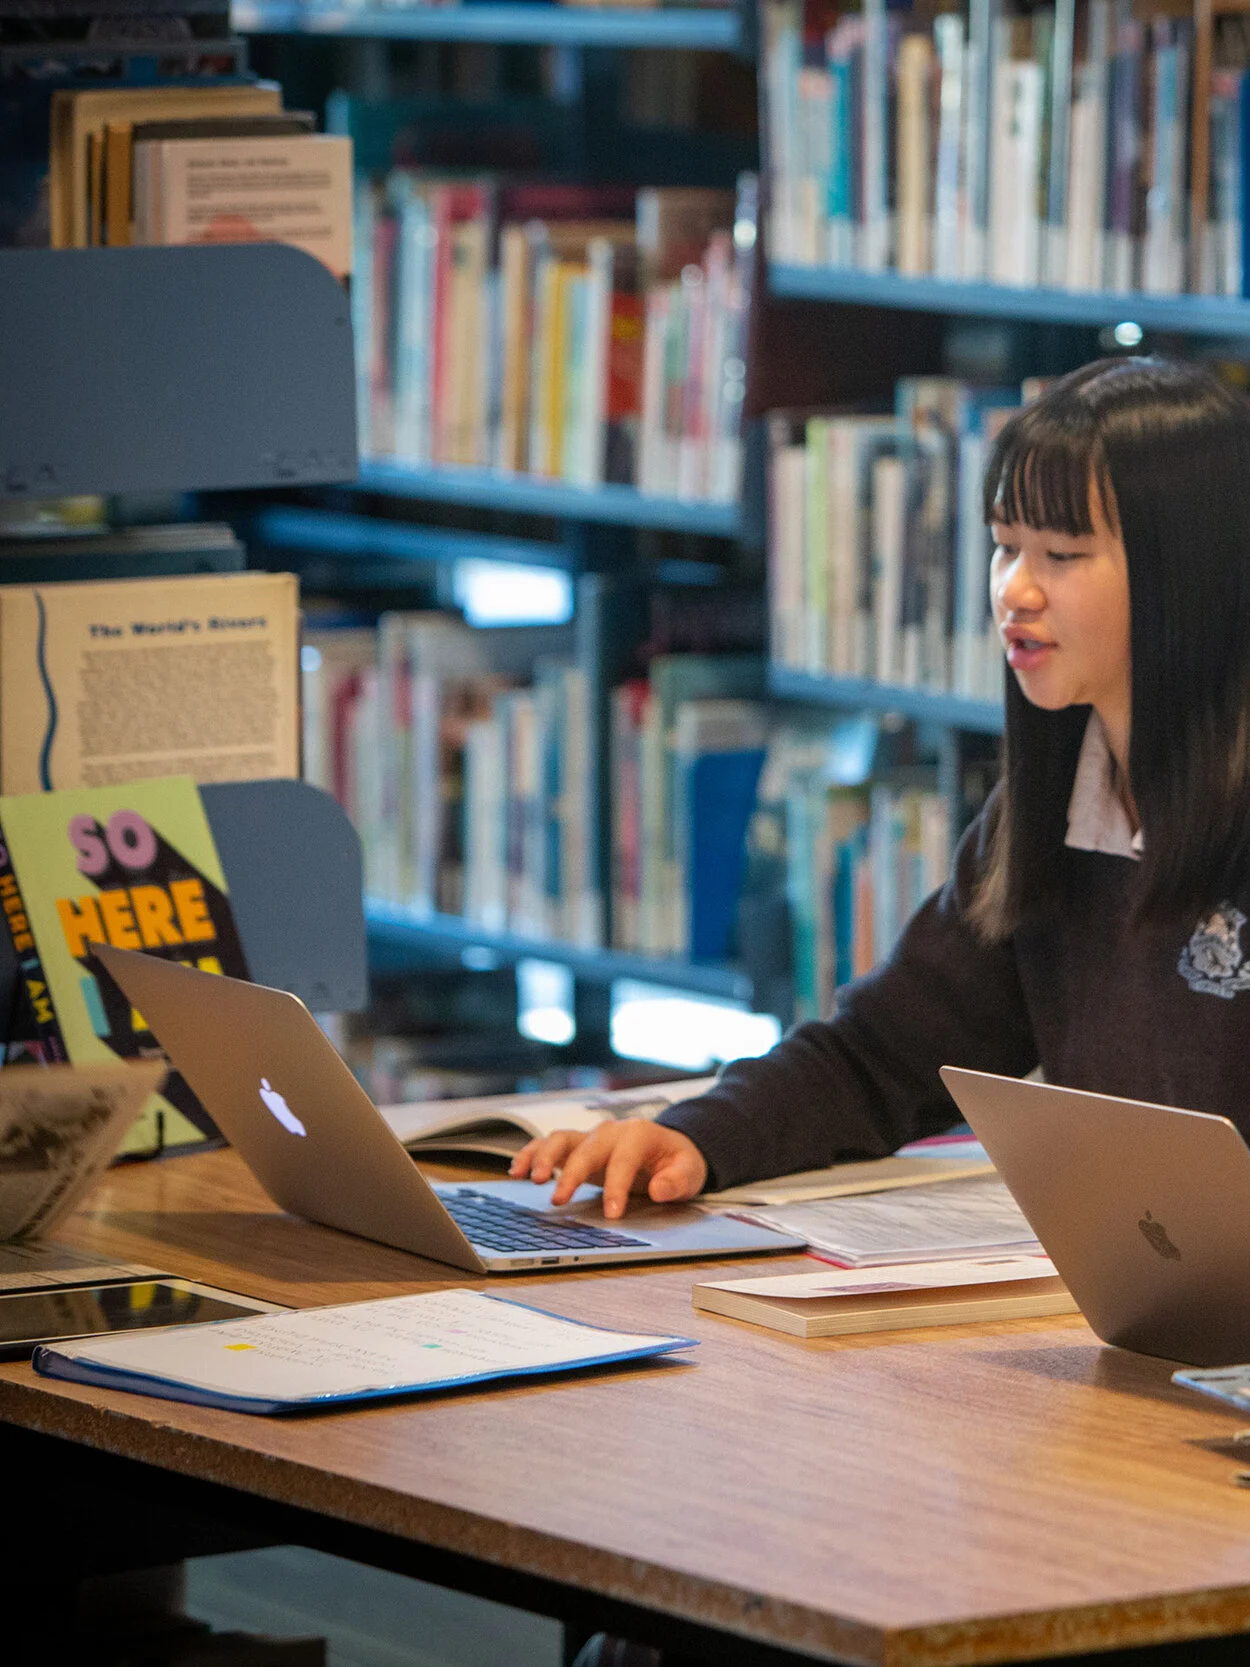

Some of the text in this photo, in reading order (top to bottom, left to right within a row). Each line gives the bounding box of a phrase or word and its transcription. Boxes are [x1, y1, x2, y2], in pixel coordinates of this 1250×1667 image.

[89, 614, 267, 639] The World's Rivers
[68, 809, 158, 876] SO
[0, 873, 34, 951] HERE
[26, 979, 55, 1024] AM
[55, 878, 216, 959] HERE
